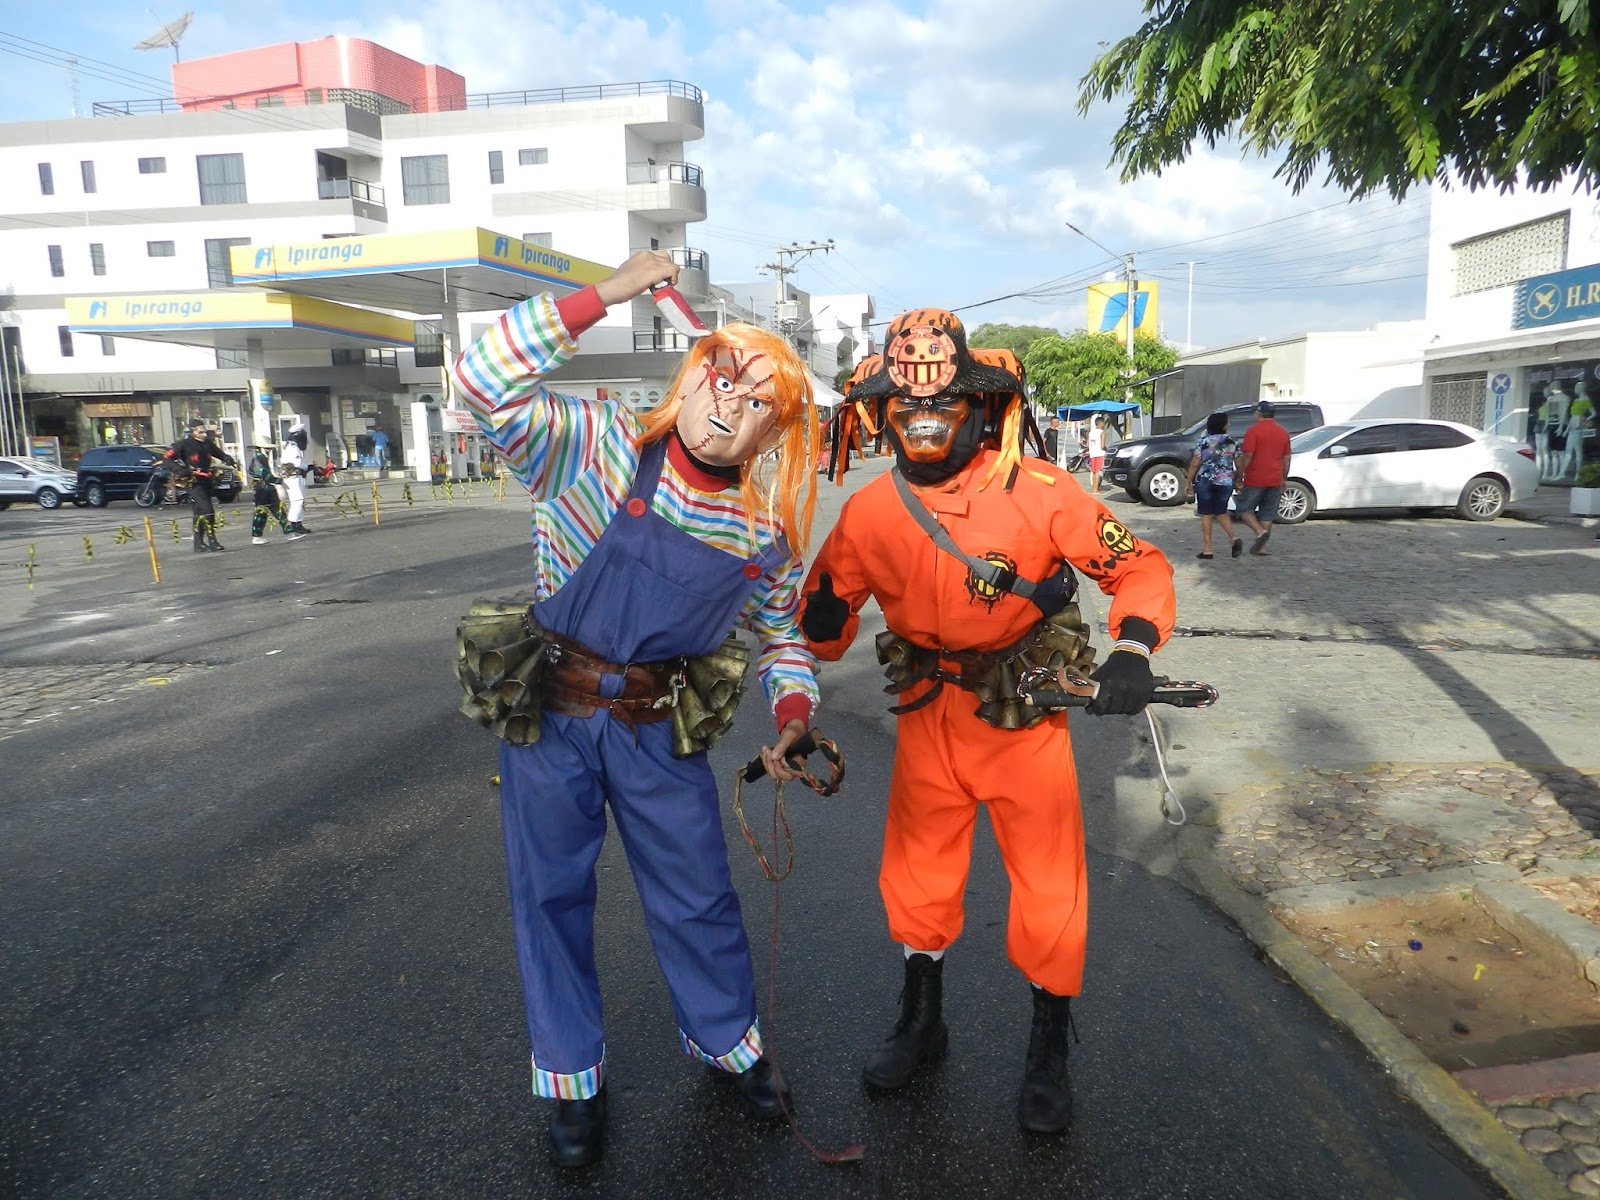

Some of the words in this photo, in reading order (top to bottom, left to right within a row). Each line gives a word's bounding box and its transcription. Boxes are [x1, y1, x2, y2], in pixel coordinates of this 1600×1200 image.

[288, 243, 363, 266] Ipiranga
[521, 243, 571, 273] Ipiranga
[125, 301, 202, 319] Ipiranga
